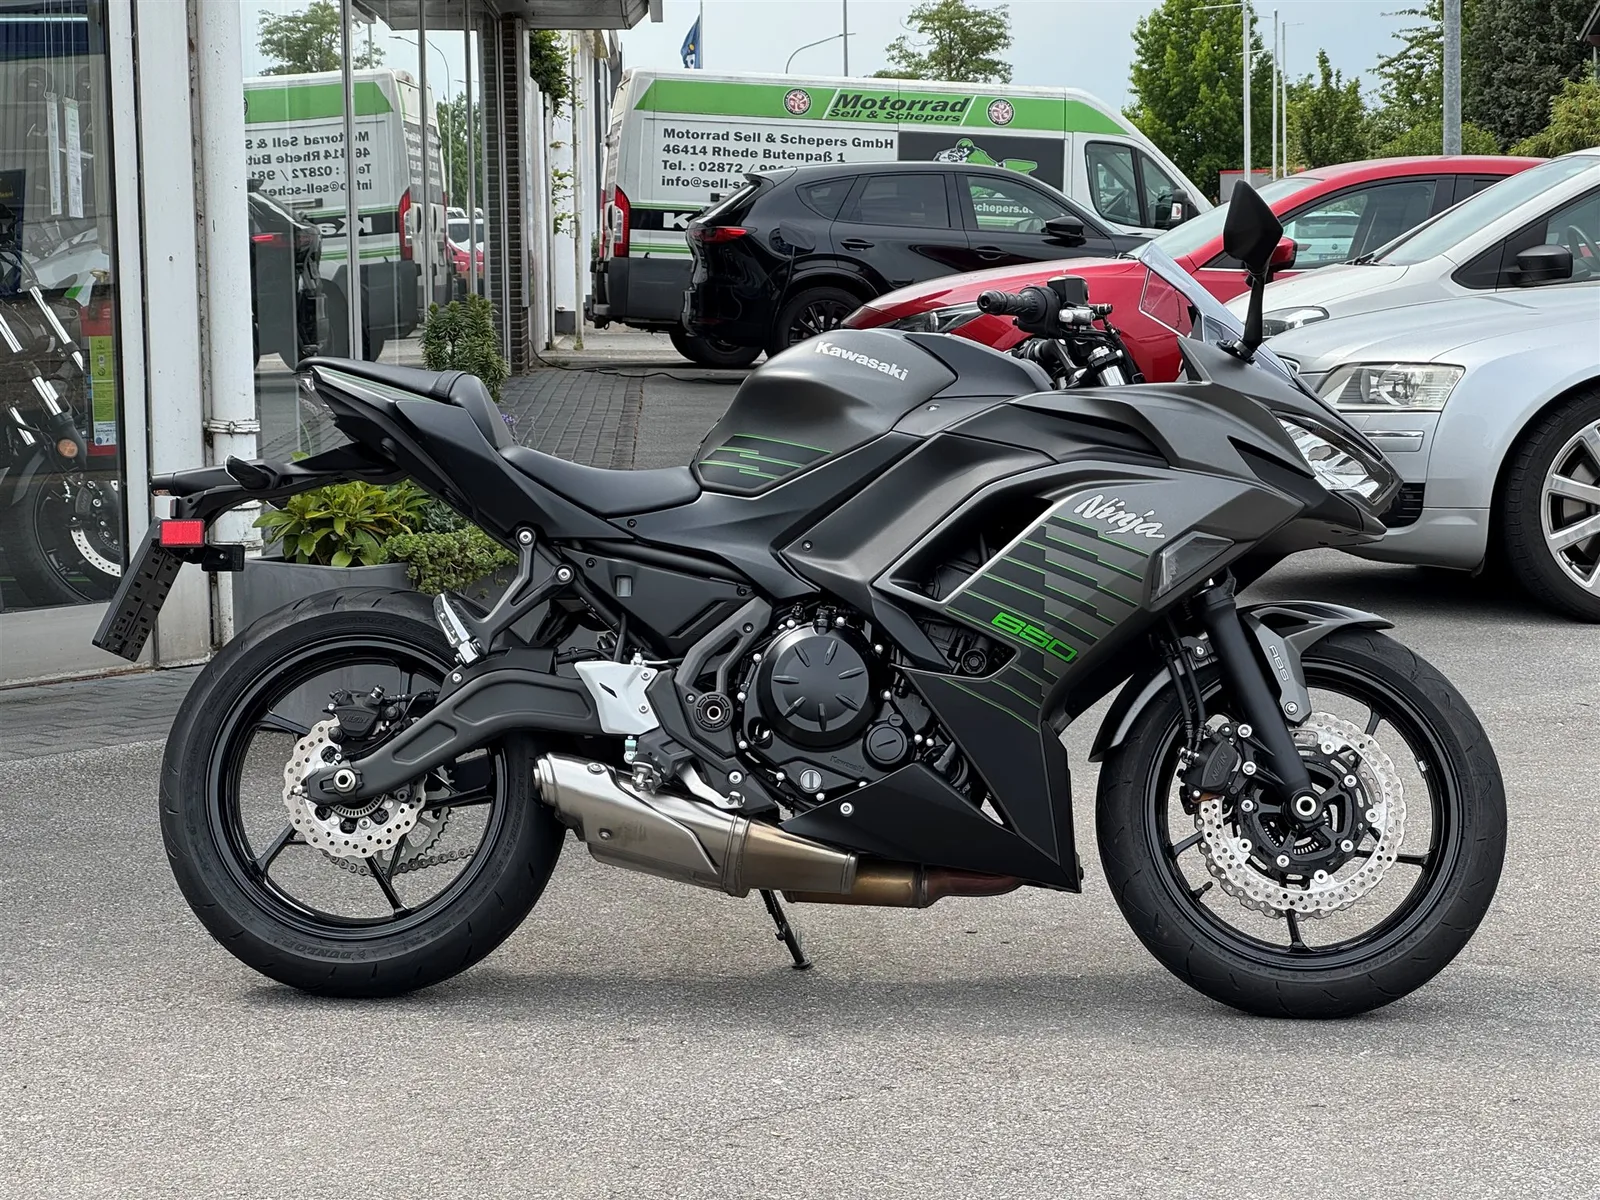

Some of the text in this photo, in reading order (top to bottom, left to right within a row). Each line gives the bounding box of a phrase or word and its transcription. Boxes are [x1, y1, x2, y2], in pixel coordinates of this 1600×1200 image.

[833, 93, 971, 113] Motorrad
[829, 108, 961, 123] Sell & Schepers
[663, 128, 894, 150] Motorrad Sell & Schepers GmbH
[662, 143, 846, 163] 46414 Rhede Butenpaß 1
[662, 159, 687, 171] Tel.
[698, 161, 743, 174] 02872
[815, 341, 909, 381] Kawasaki
[1073, 494, 1166, 539] Ninja
[991, 611, 1078, 662] 650
[1268, 644, 1290, 682] ABS
